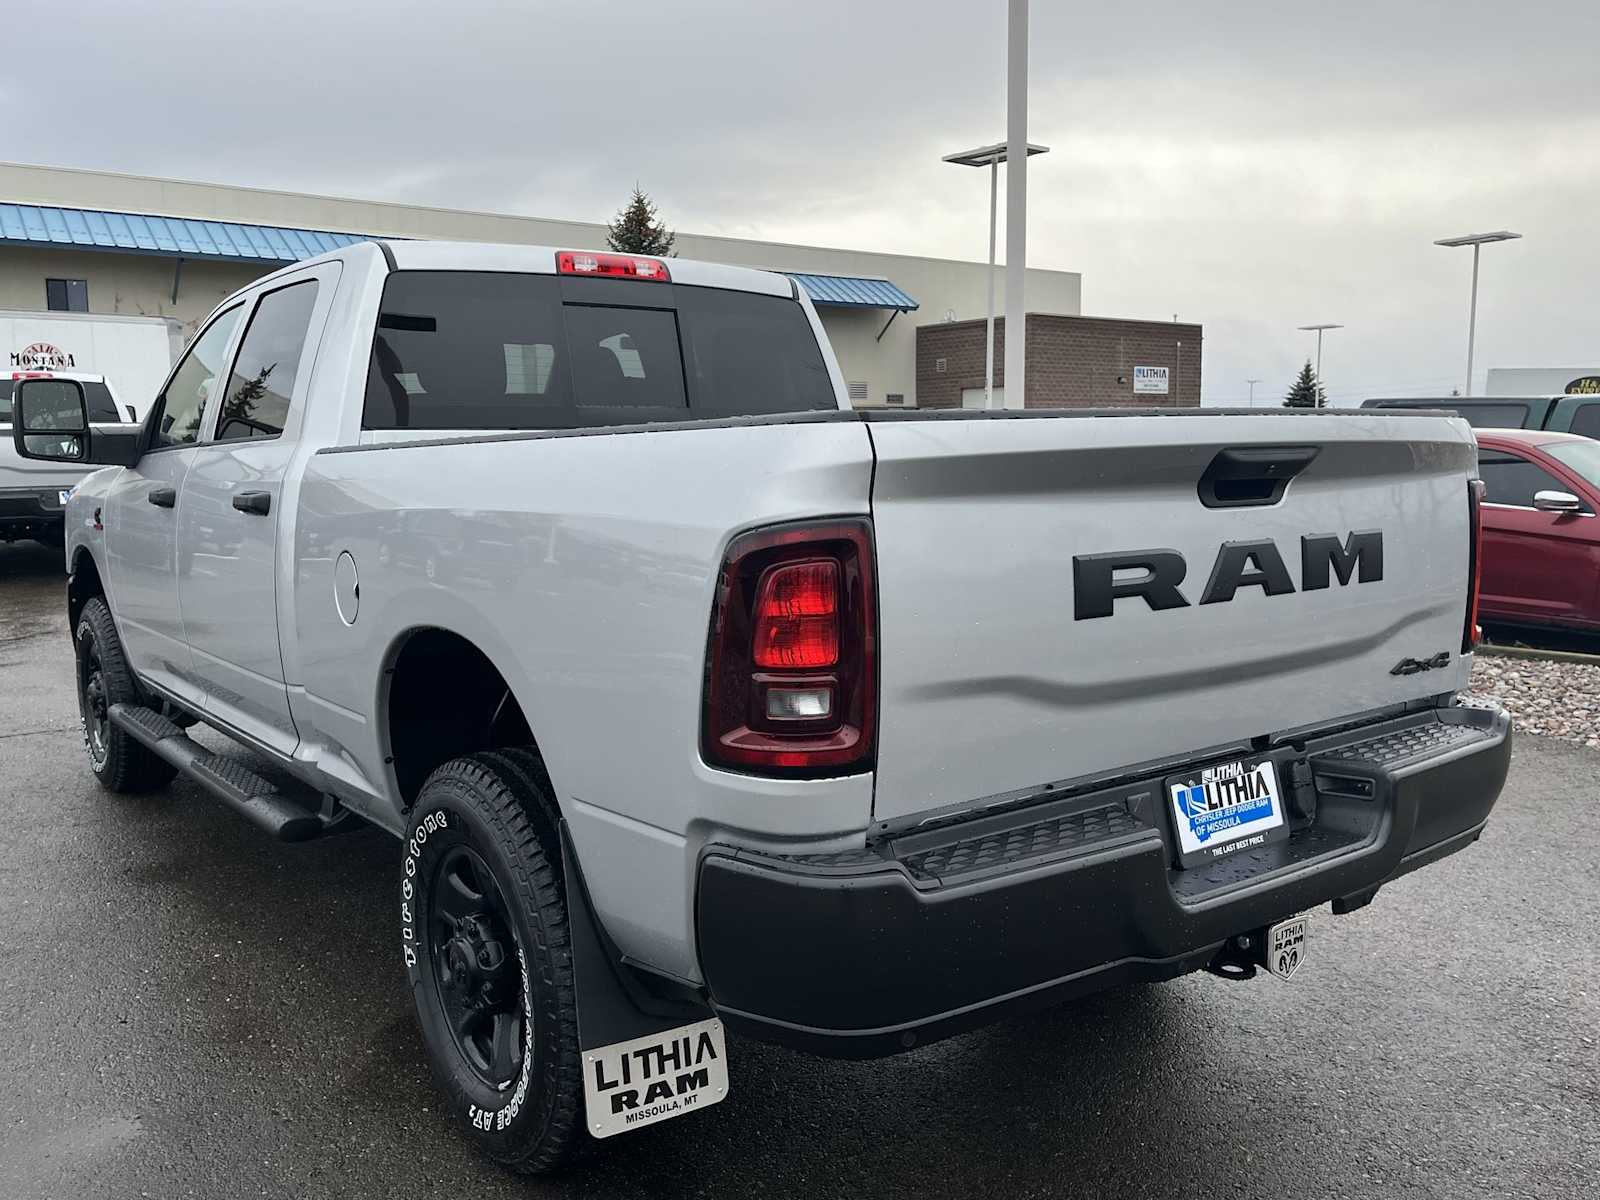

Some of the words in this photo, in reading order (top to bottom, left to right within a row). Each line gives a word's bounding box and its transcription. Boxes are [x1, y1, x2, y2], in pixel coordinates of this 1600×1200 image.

[10, 352, 75, 367] MONTANA
[1143, 368, 1166, 378] LITHIA
[1072, 528, 1384, 621] RAM
[1211, 761, 1244, 780] LITHIA
[1205, 771, 1270, 811] LITHIA
[1194, 810, 1224, 825] CHRYSLER
[1223, 807, 1237, 818] JEEP
[1237, 803, 1256, 814] DODGE
[1255, 799, 1269, 809] RAM
[1196, 826, 1206, 836] OF
[1207, 815, 1241, 834] MISSOULA
[1212, 848, 1223, 857] THE
[1223, 843, 1236, 854] LAST
[1236, 839, 1249, 850] BEST
[1249, 835, 1265, 846] PRICE
[1275, 935, 1303, 952] RAM
[1276, 924, 1303, 942] LITHIA
[594, 1031, 718, 1092] LITHIA
[610, 1067, 709, 1115] RAM
[469, 1104, 494, 1131] AT2
[625, 1101, 682, 1124] MISSOULA,
[684, 1094, 698, 1107] MT
